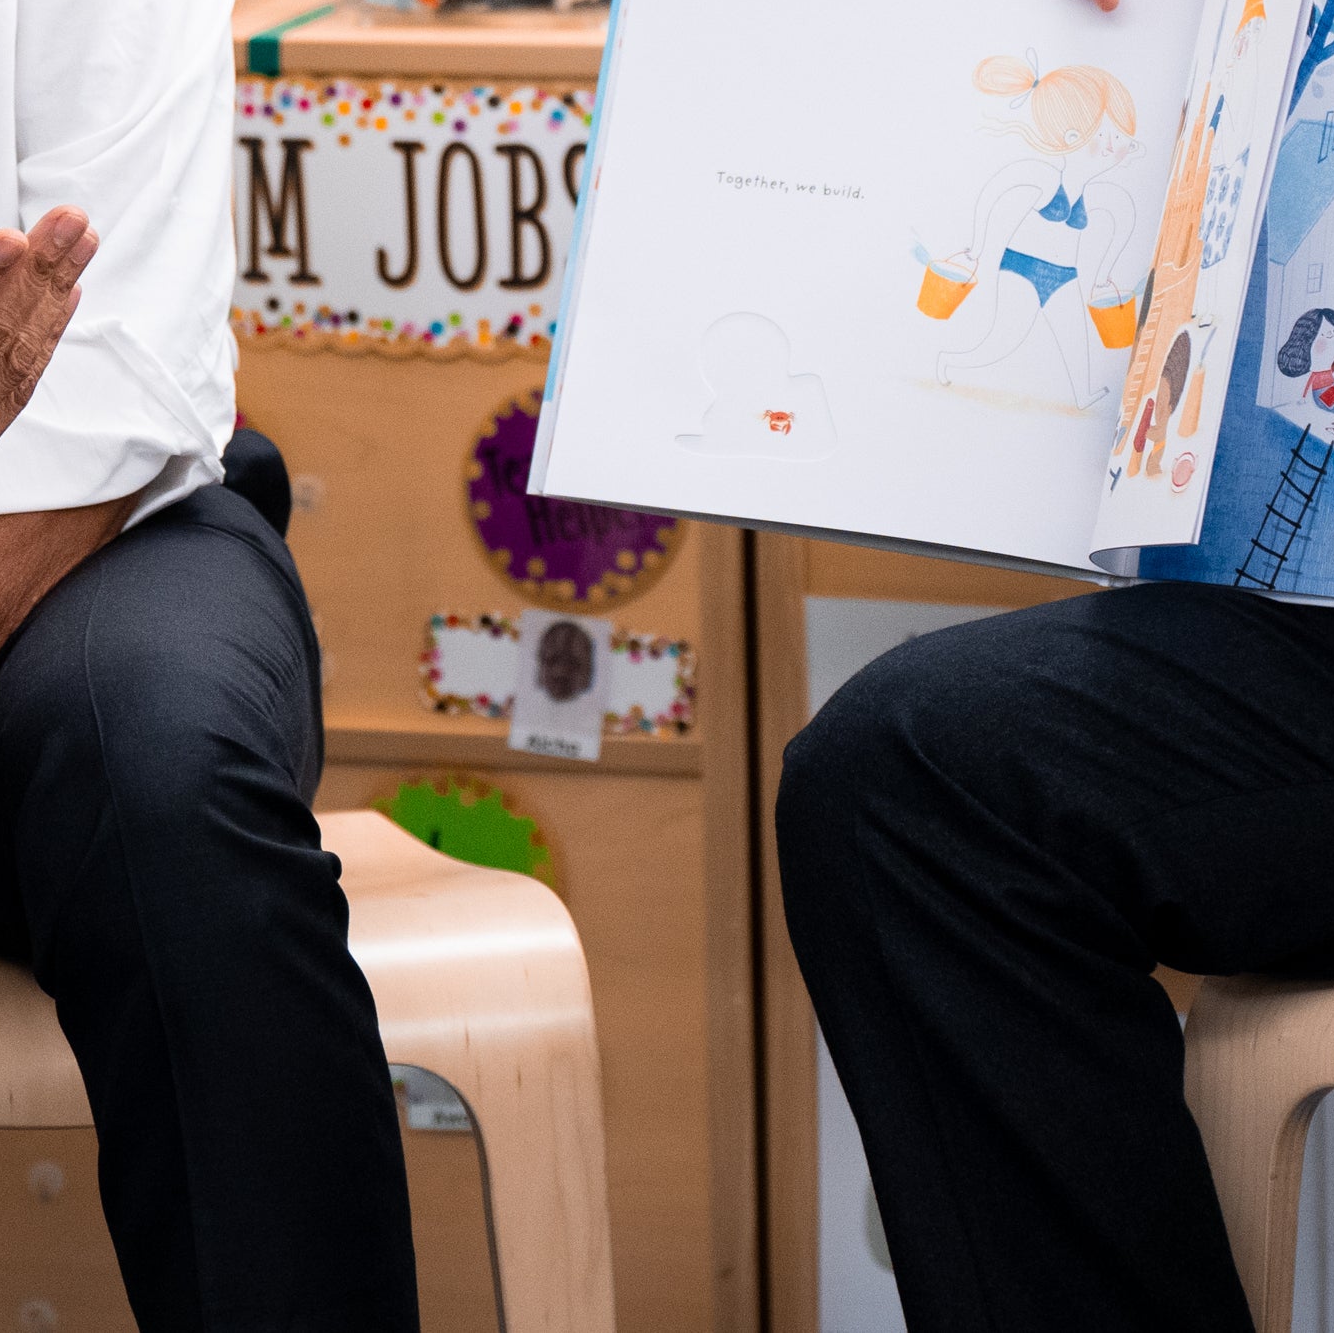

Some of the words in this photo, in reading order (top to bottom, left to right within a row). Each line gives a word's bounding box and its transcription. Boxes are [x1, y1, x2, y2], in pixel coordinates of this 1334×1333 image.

[234, 136, 323, 288] M
[717, 170, 789, 194] Together,
[795, 182, 818, 195] we
[822, 182, 866, 200] build.
